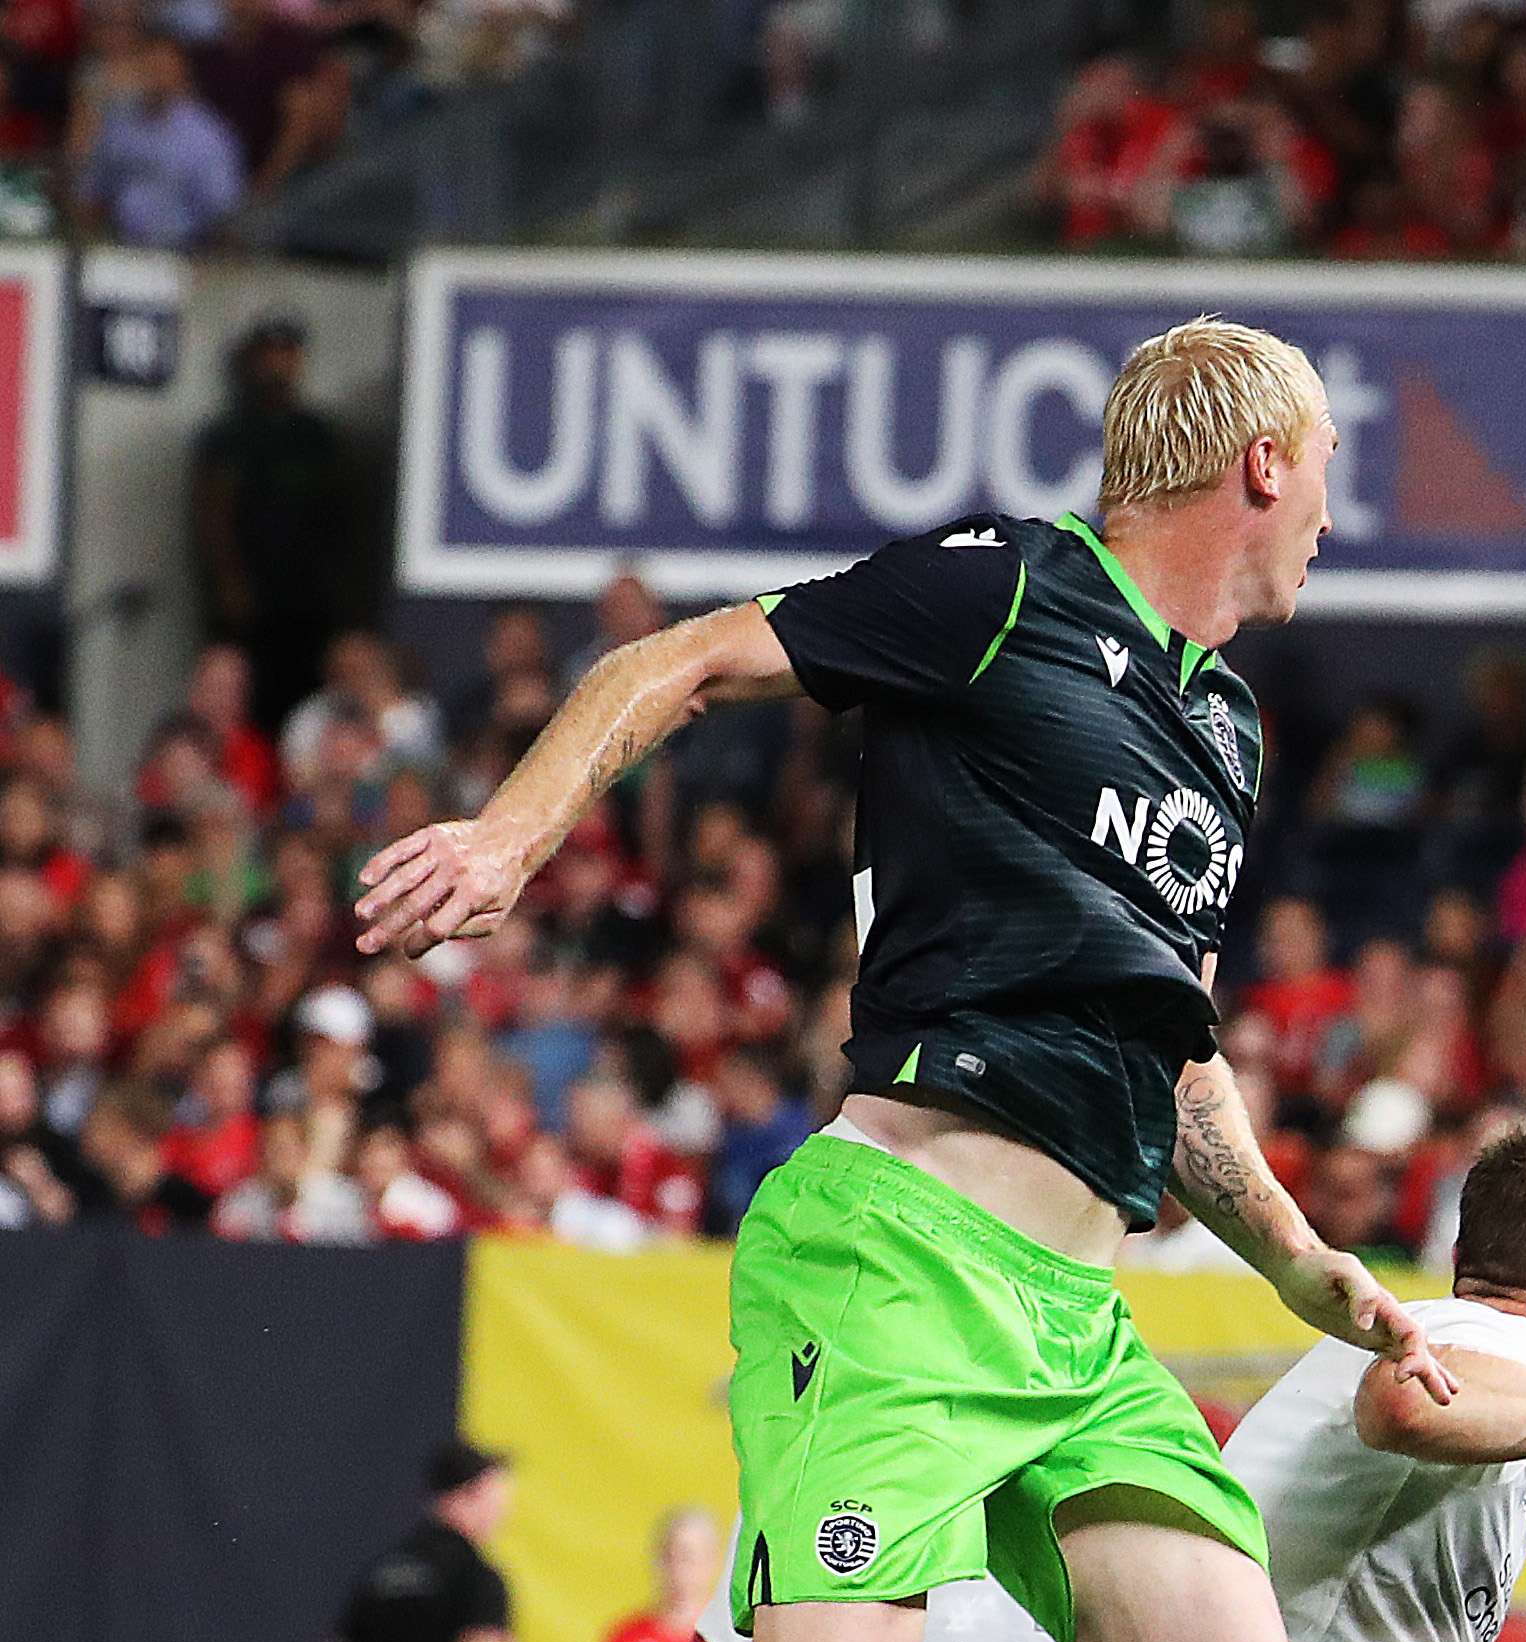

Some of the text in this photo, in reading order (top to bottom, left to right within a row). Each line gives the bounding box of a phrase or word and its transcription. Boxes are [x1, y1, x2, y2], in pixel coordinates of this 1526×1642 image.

[458, 325, 1384, 545] UNTUCt
[1090, 787, 1243, 916] NOS
[830, 1499, 873, 1513] SCP
